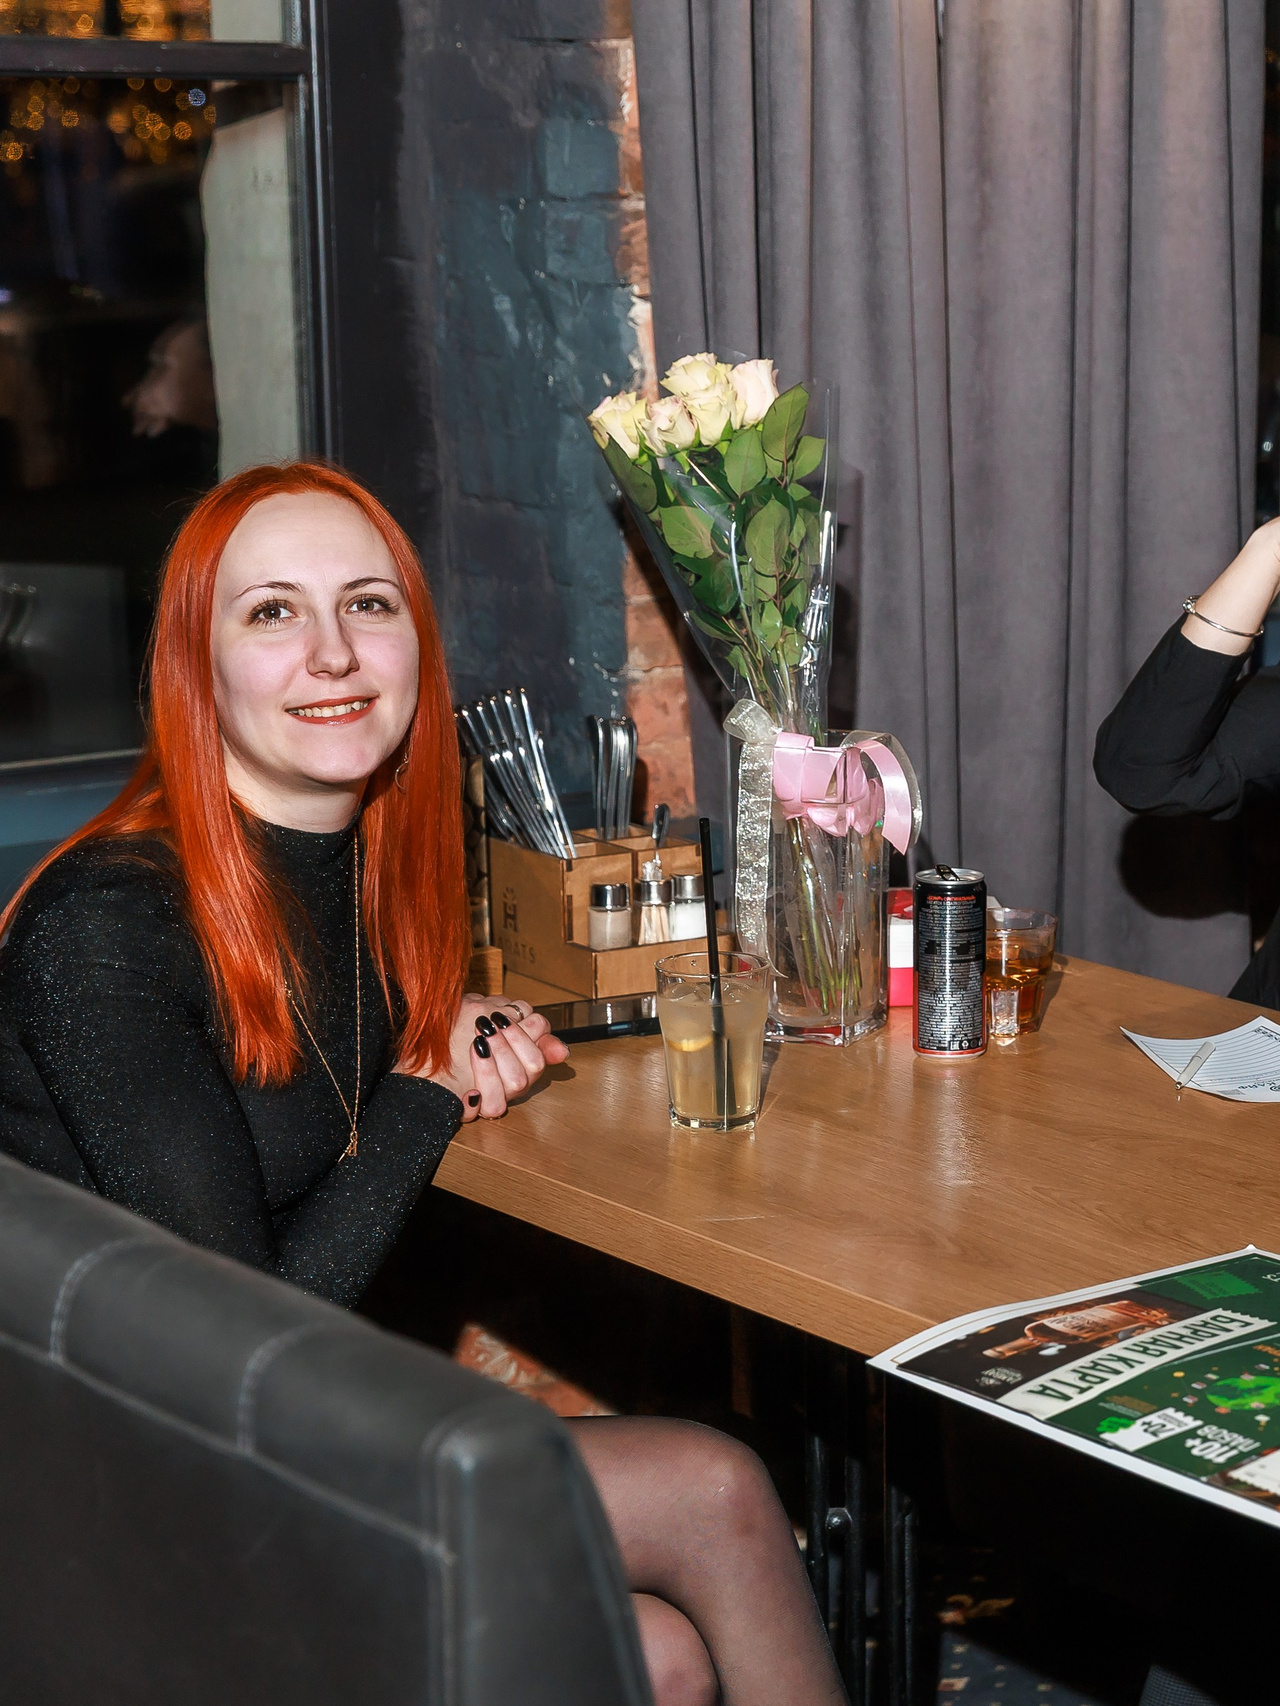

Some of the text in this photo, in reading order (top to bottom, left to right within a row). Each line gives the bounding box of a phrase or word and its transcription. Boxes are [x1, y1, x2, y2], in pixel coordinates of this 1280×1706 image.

[1122, 1313, 1255, 1358] БАРНАЯ
[1026, 1352, 1146, 1402] КАРТА
[1184, 1434, 1242, 1465] 110+
[1196, 1423, 1262, 1454] ПАБОВ
